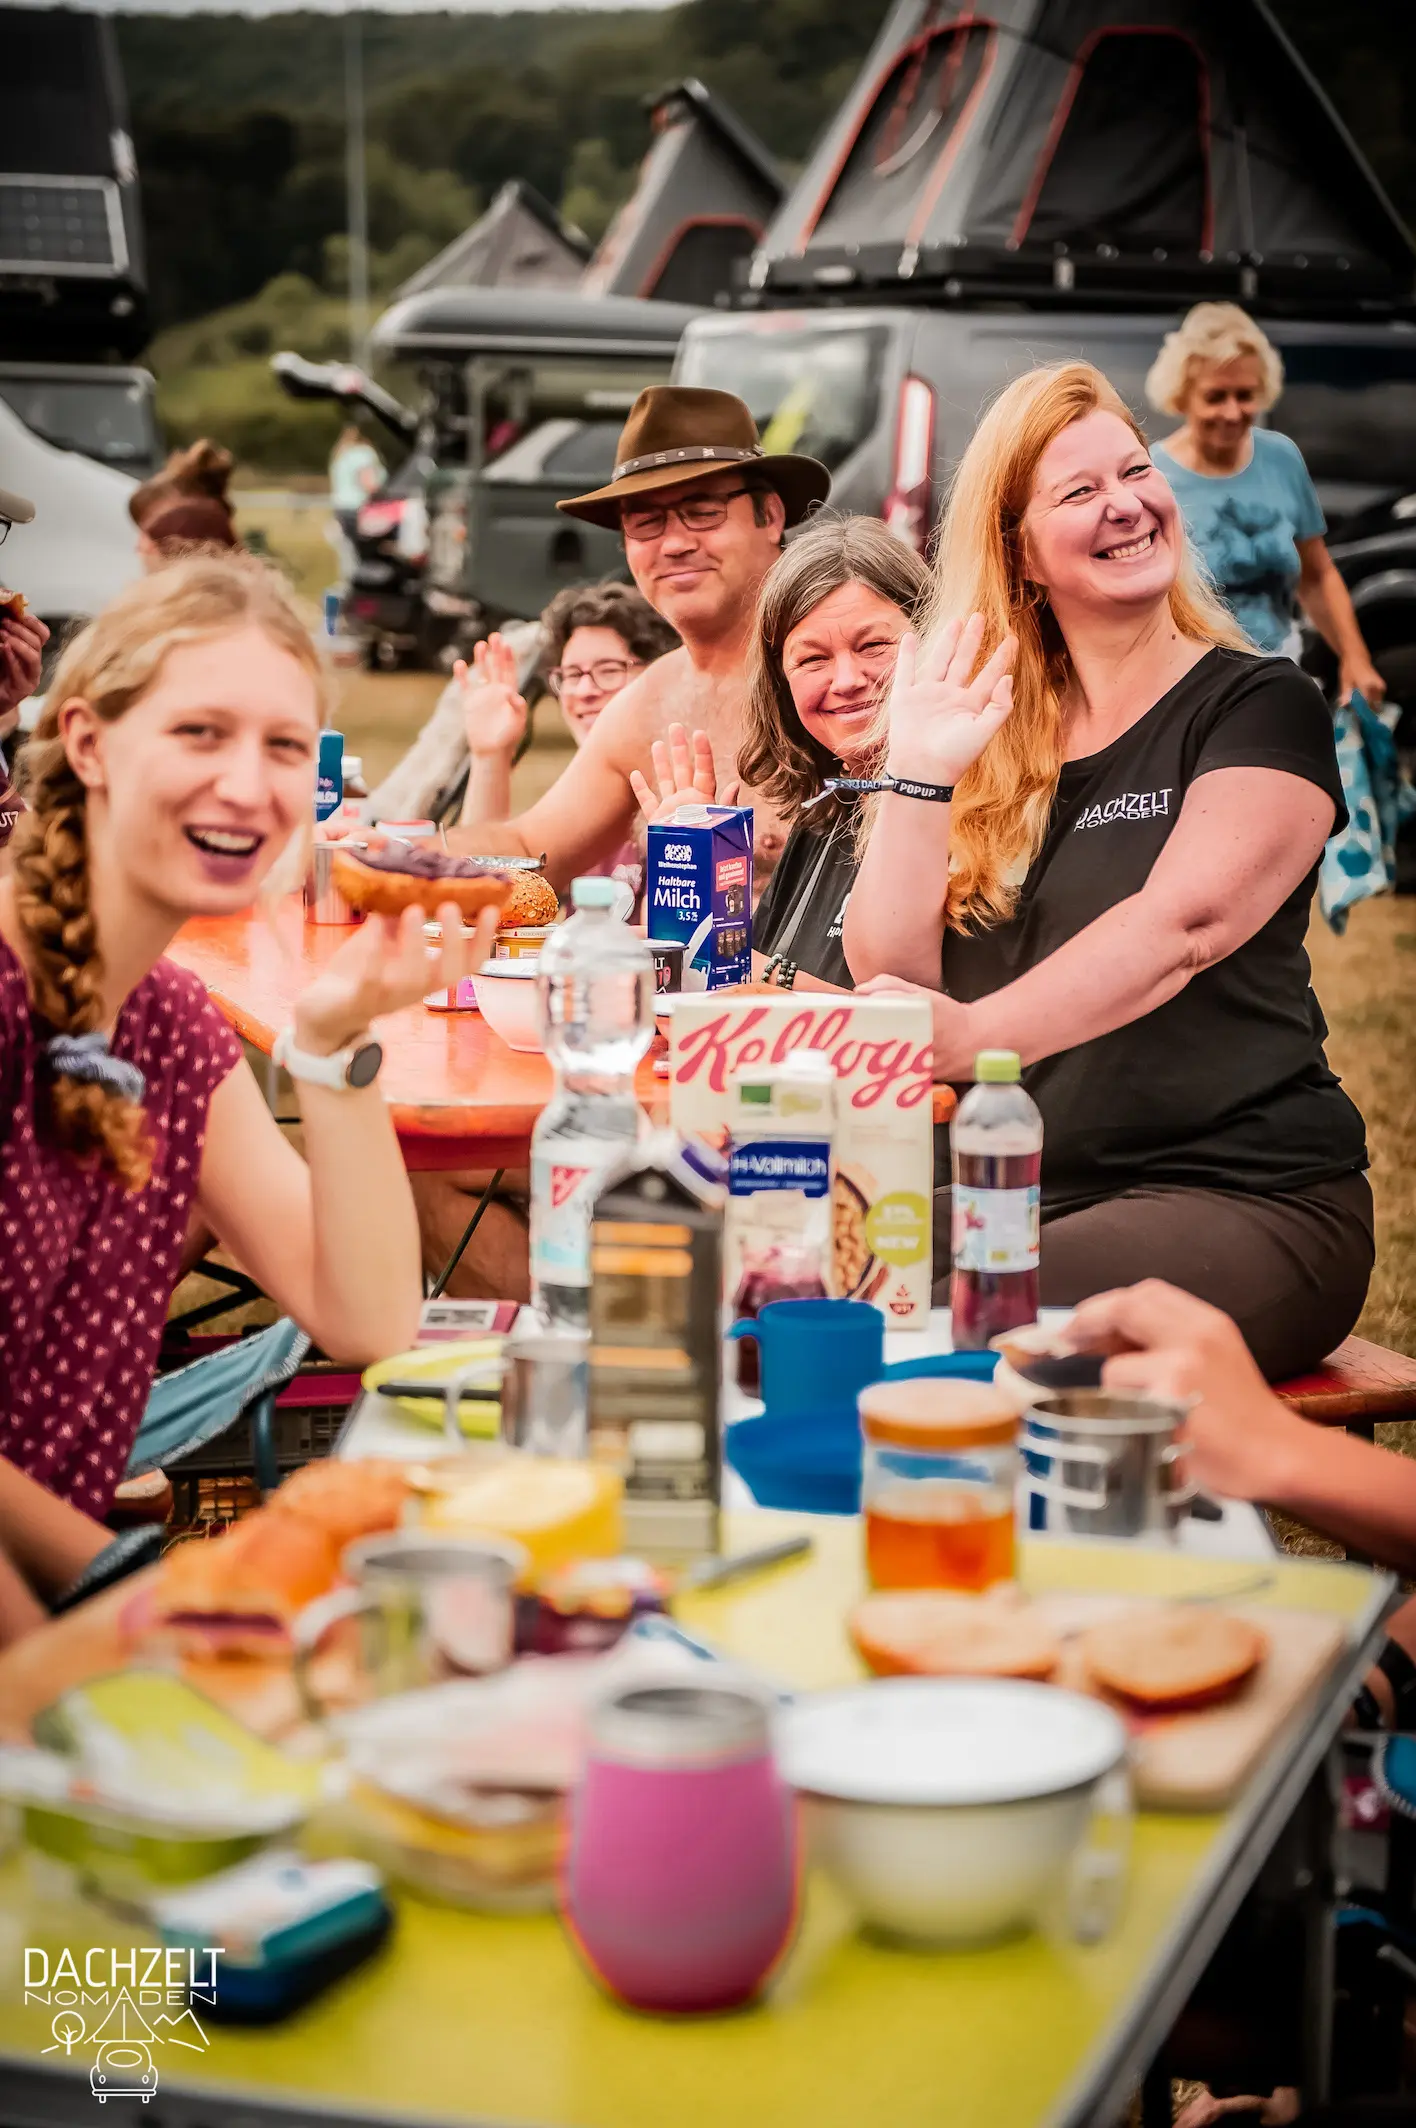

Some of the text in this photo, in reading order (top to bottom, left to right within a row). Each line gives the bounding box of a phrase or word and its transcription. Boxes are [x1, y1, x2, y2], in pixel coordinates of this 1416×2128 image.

[899, 783, 936, 798] POPUP
[1074, 807, 1168, 833] NOMADEN
[658, 876, 696, 888] Haltbare
[653, 887, 701, 909] Milch
[678, 911, 691, 921] 3,5
